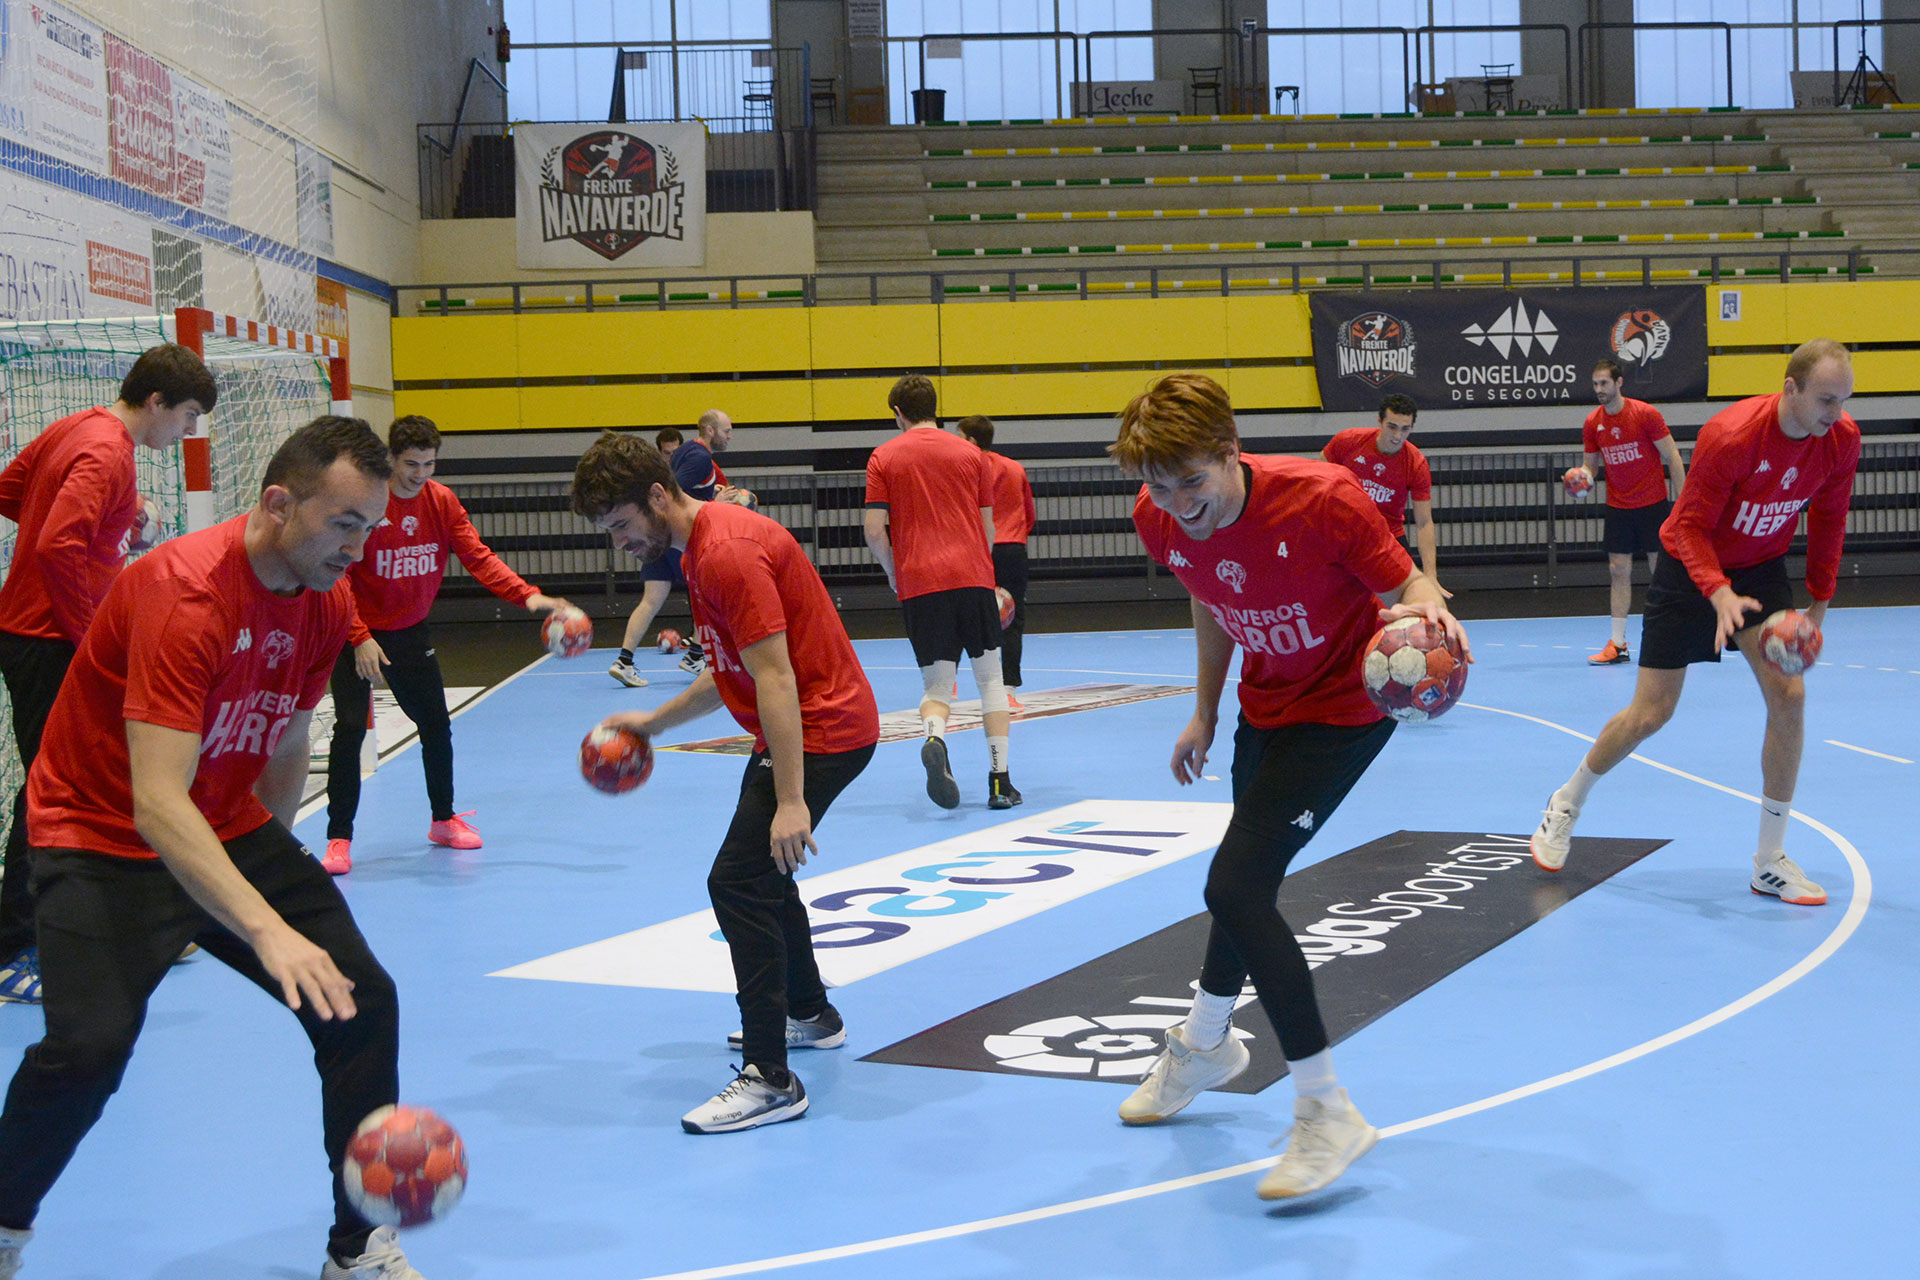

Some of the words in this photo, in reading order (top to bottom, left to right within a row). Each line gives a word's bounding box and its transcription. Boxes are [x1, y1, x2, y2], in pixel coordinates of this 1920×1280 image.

[1093, 86, 1154, 115] Leche
[584, 178, 633, 194] FRENTE
[541, 184, 684, 241] NAVAVERDE
[1361, 339, 1389, 350] FRENTE
[1338, 344, 1416, 377] NAVAVERDE
[1444, 364, 1577, 386] CONGELADOS
[1452, 389, 1475, 401] DE
[1487, 388, 1571, 401] SEGOVIA
[394, 542, 439, 560] VIVEROS
[1277, 541, 1289, 558] 4
[376, 548, 438, 579] HEROL
